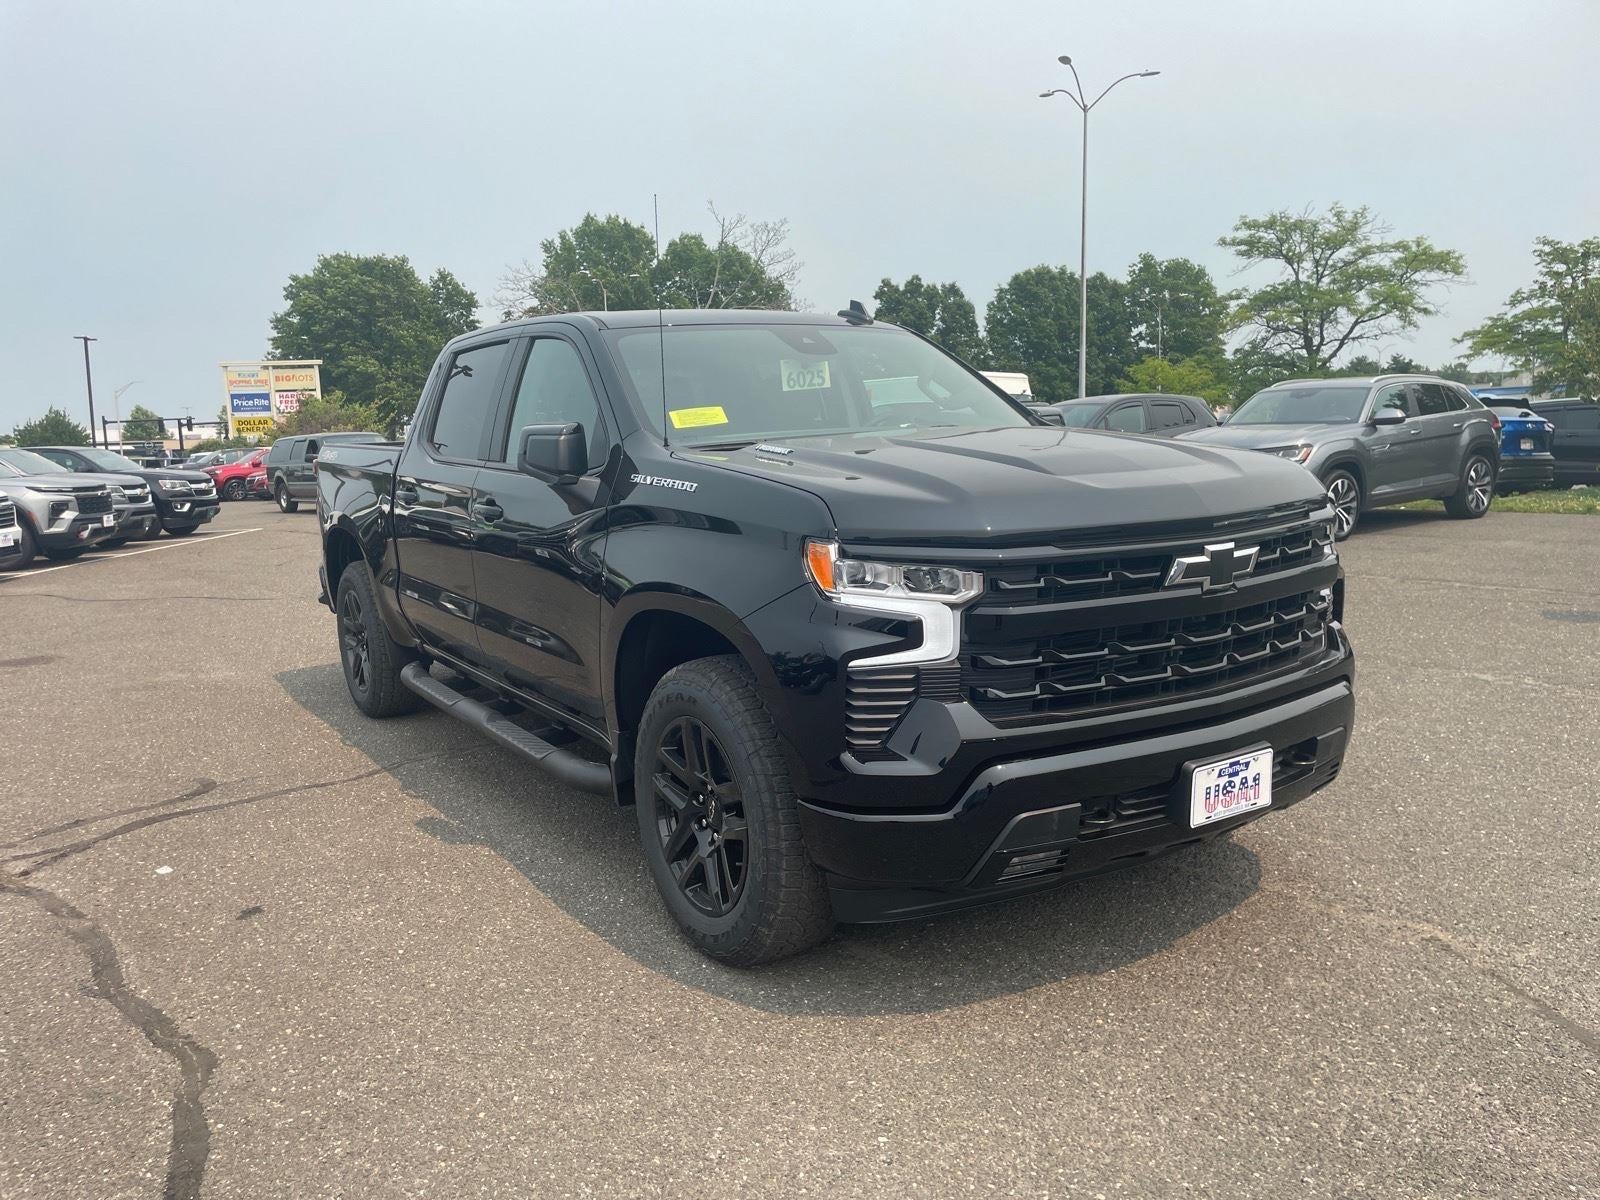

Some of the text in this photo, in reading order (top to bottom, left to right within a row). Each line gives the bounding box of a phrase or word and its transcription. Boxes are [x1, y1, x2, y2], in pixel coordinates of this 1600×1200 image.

[786, 369, 826, 389] 6025
[233, 398, 270, 407] Price Rite
[237, 419, 269, 427] DOLLAR
[630, 473, 698, 492] SILVERADO
[1220, 763, 1248, 776] CENTRAL
